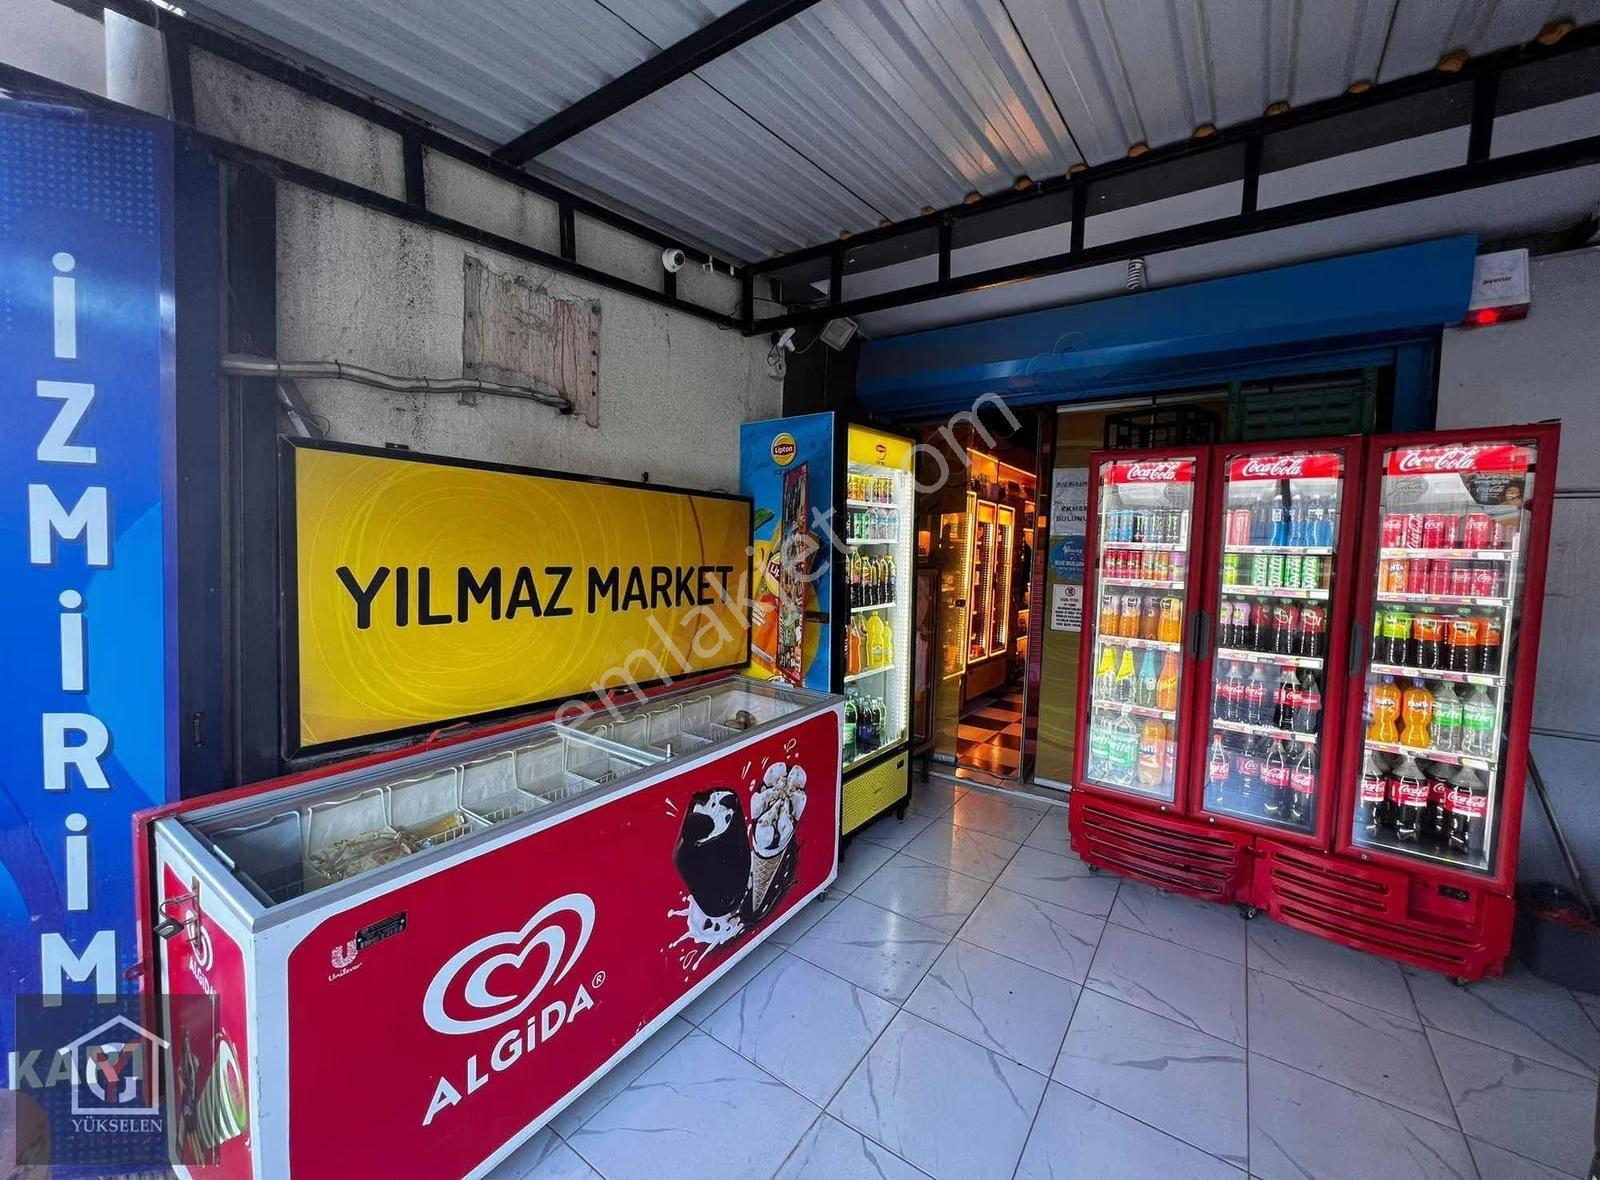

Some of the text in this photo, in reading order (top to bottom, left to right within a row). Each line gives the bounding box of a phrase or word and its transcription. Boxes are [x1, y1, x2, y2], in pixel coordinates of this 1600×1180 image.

[774, 445, 793, 455] Lipton
[1242, 458, 1304, 477] Coca-Cola
[1399, 449, 1479, 471] Coca-Cola
[1127, 463, 1177, 481] Coca-Cola
[336, 565, 734, 630] YILMAZ MARKET
